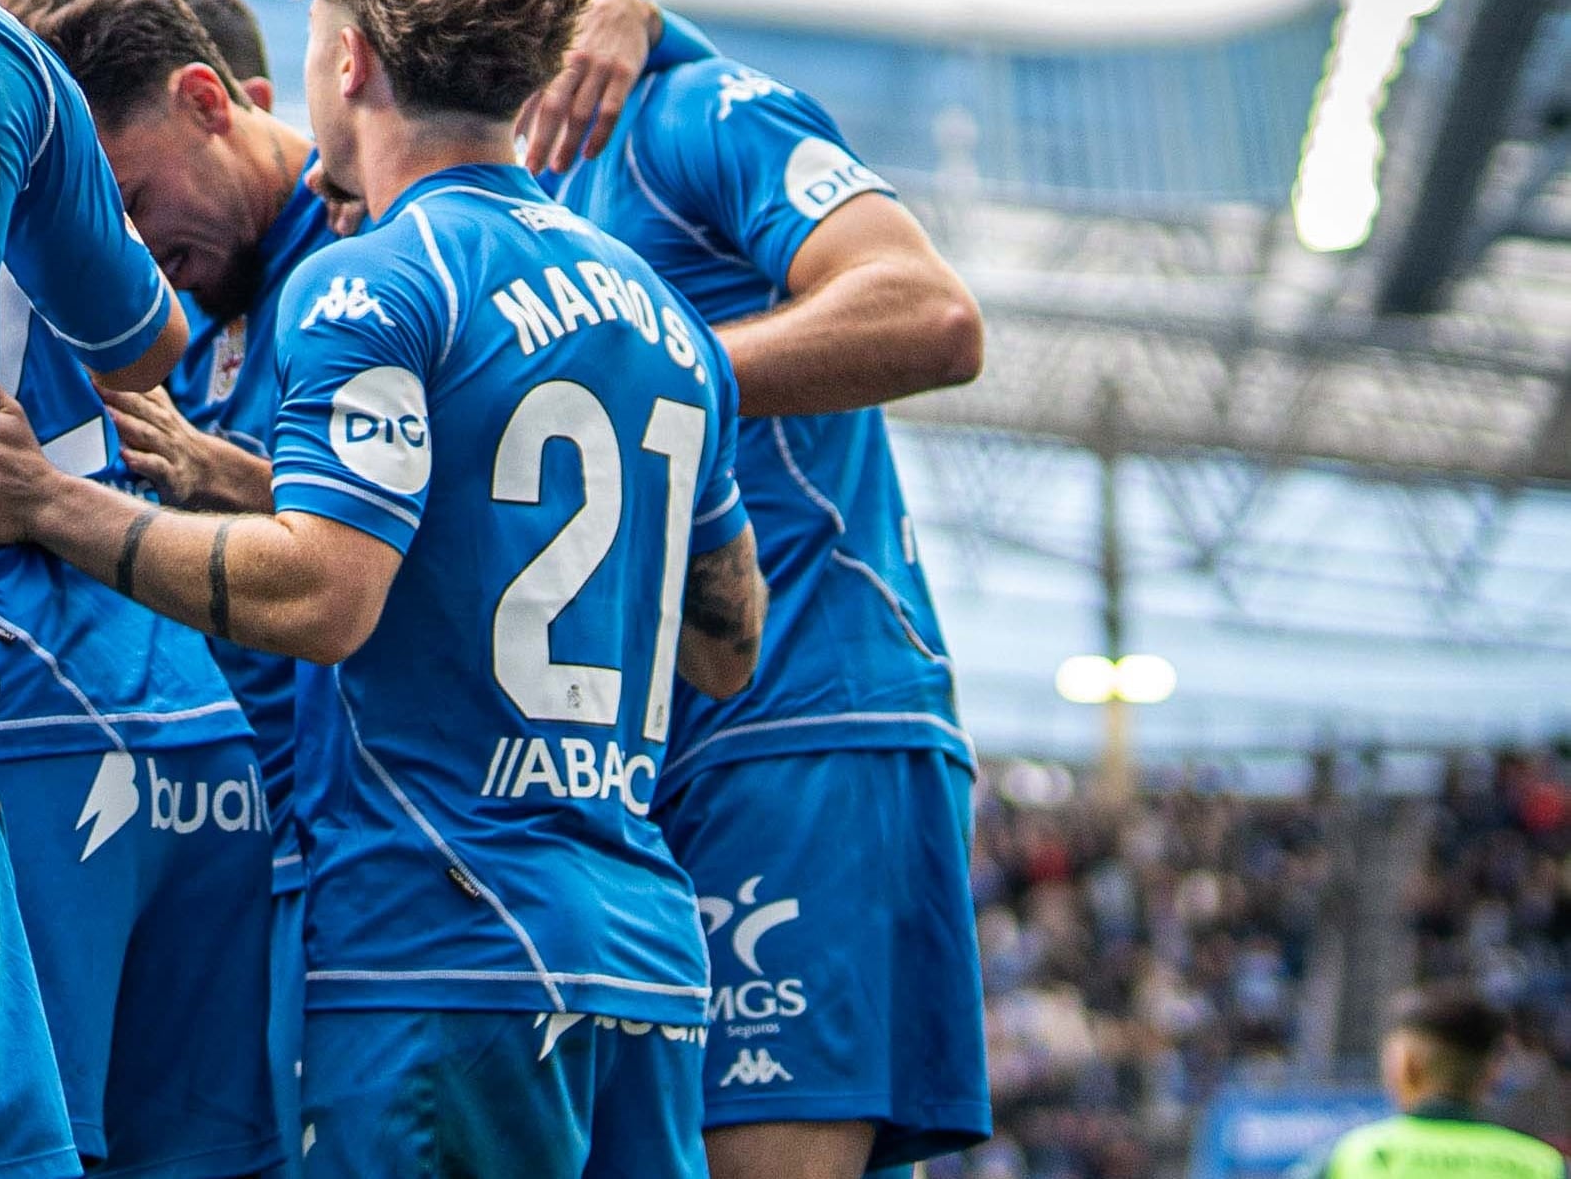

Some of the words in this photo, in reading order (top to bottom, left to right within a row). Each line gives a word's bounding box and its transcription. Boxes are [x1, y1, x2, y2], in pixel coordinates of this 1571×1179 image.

[492, 261, 659, 355] MARIO
[491, 380, 706, 743] 21
[726, 1023, 781, 1039] Seguros
